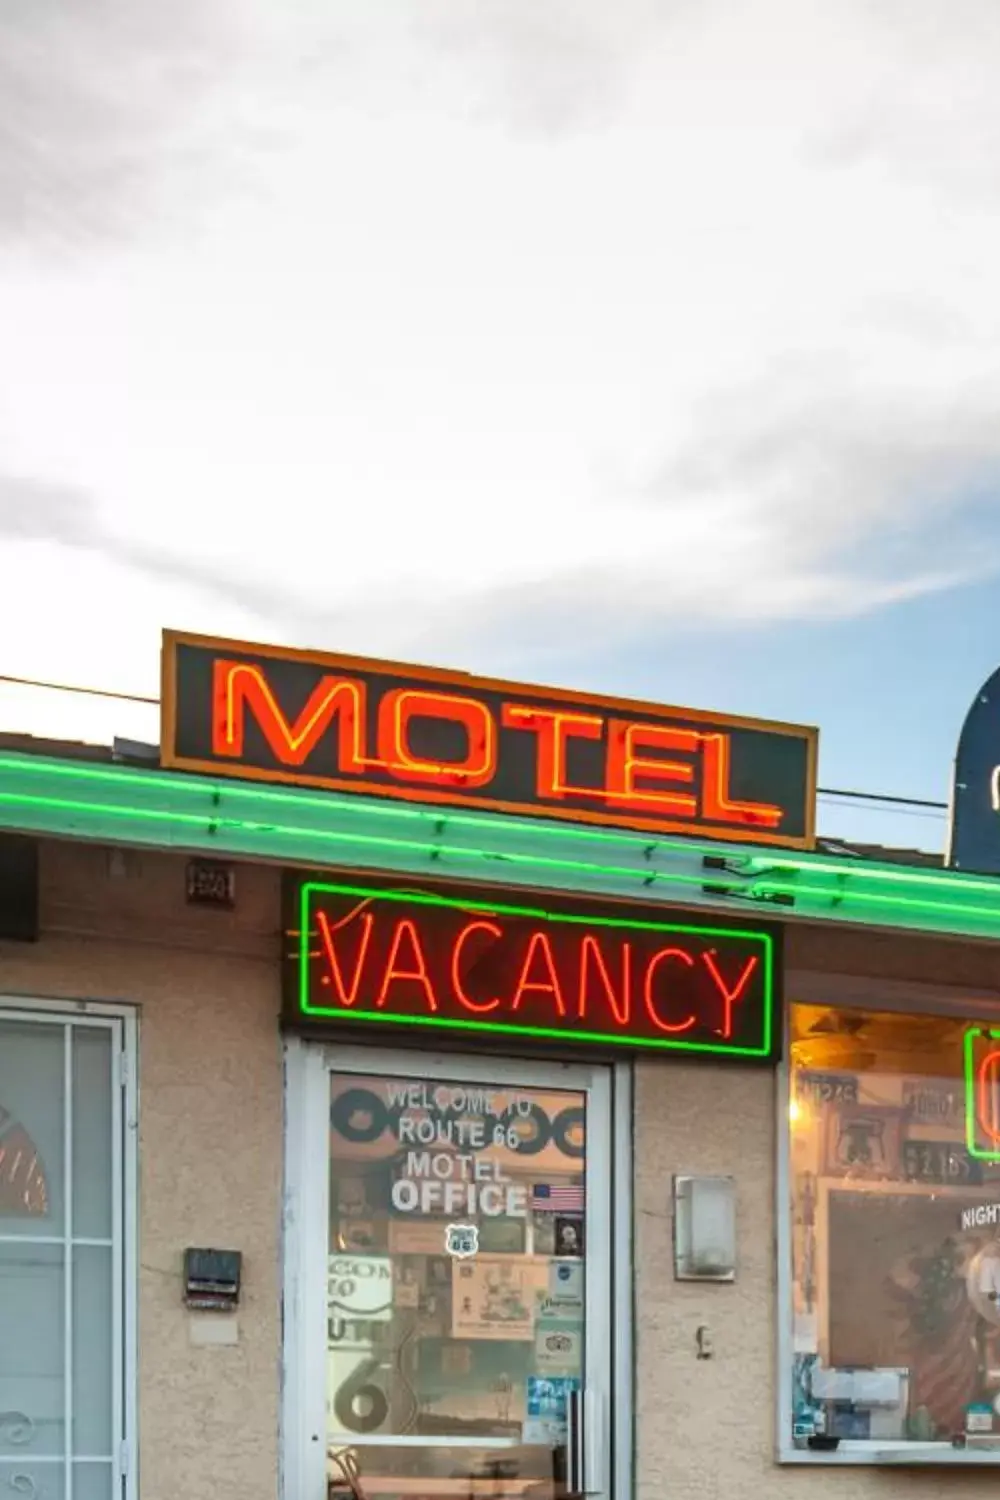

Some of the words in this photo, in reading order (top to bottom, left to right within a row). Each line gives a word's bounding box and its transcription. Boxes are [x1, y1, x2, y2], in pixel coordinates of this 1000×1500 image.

[212, 659, 783, 827] MOTEL
[316, 911, 758, 1038] VACANCY
[385, 1081, 497, 1115] WELCOME
[505, 1094, 533, 1118] TO
[398, 1117, 485, 1147] ROUTE
[492, 1124, 520, 1149] 66
[406, 1151, 513, 1183] MOTEL
[391, 1179, 528, 1217] OFFICE
